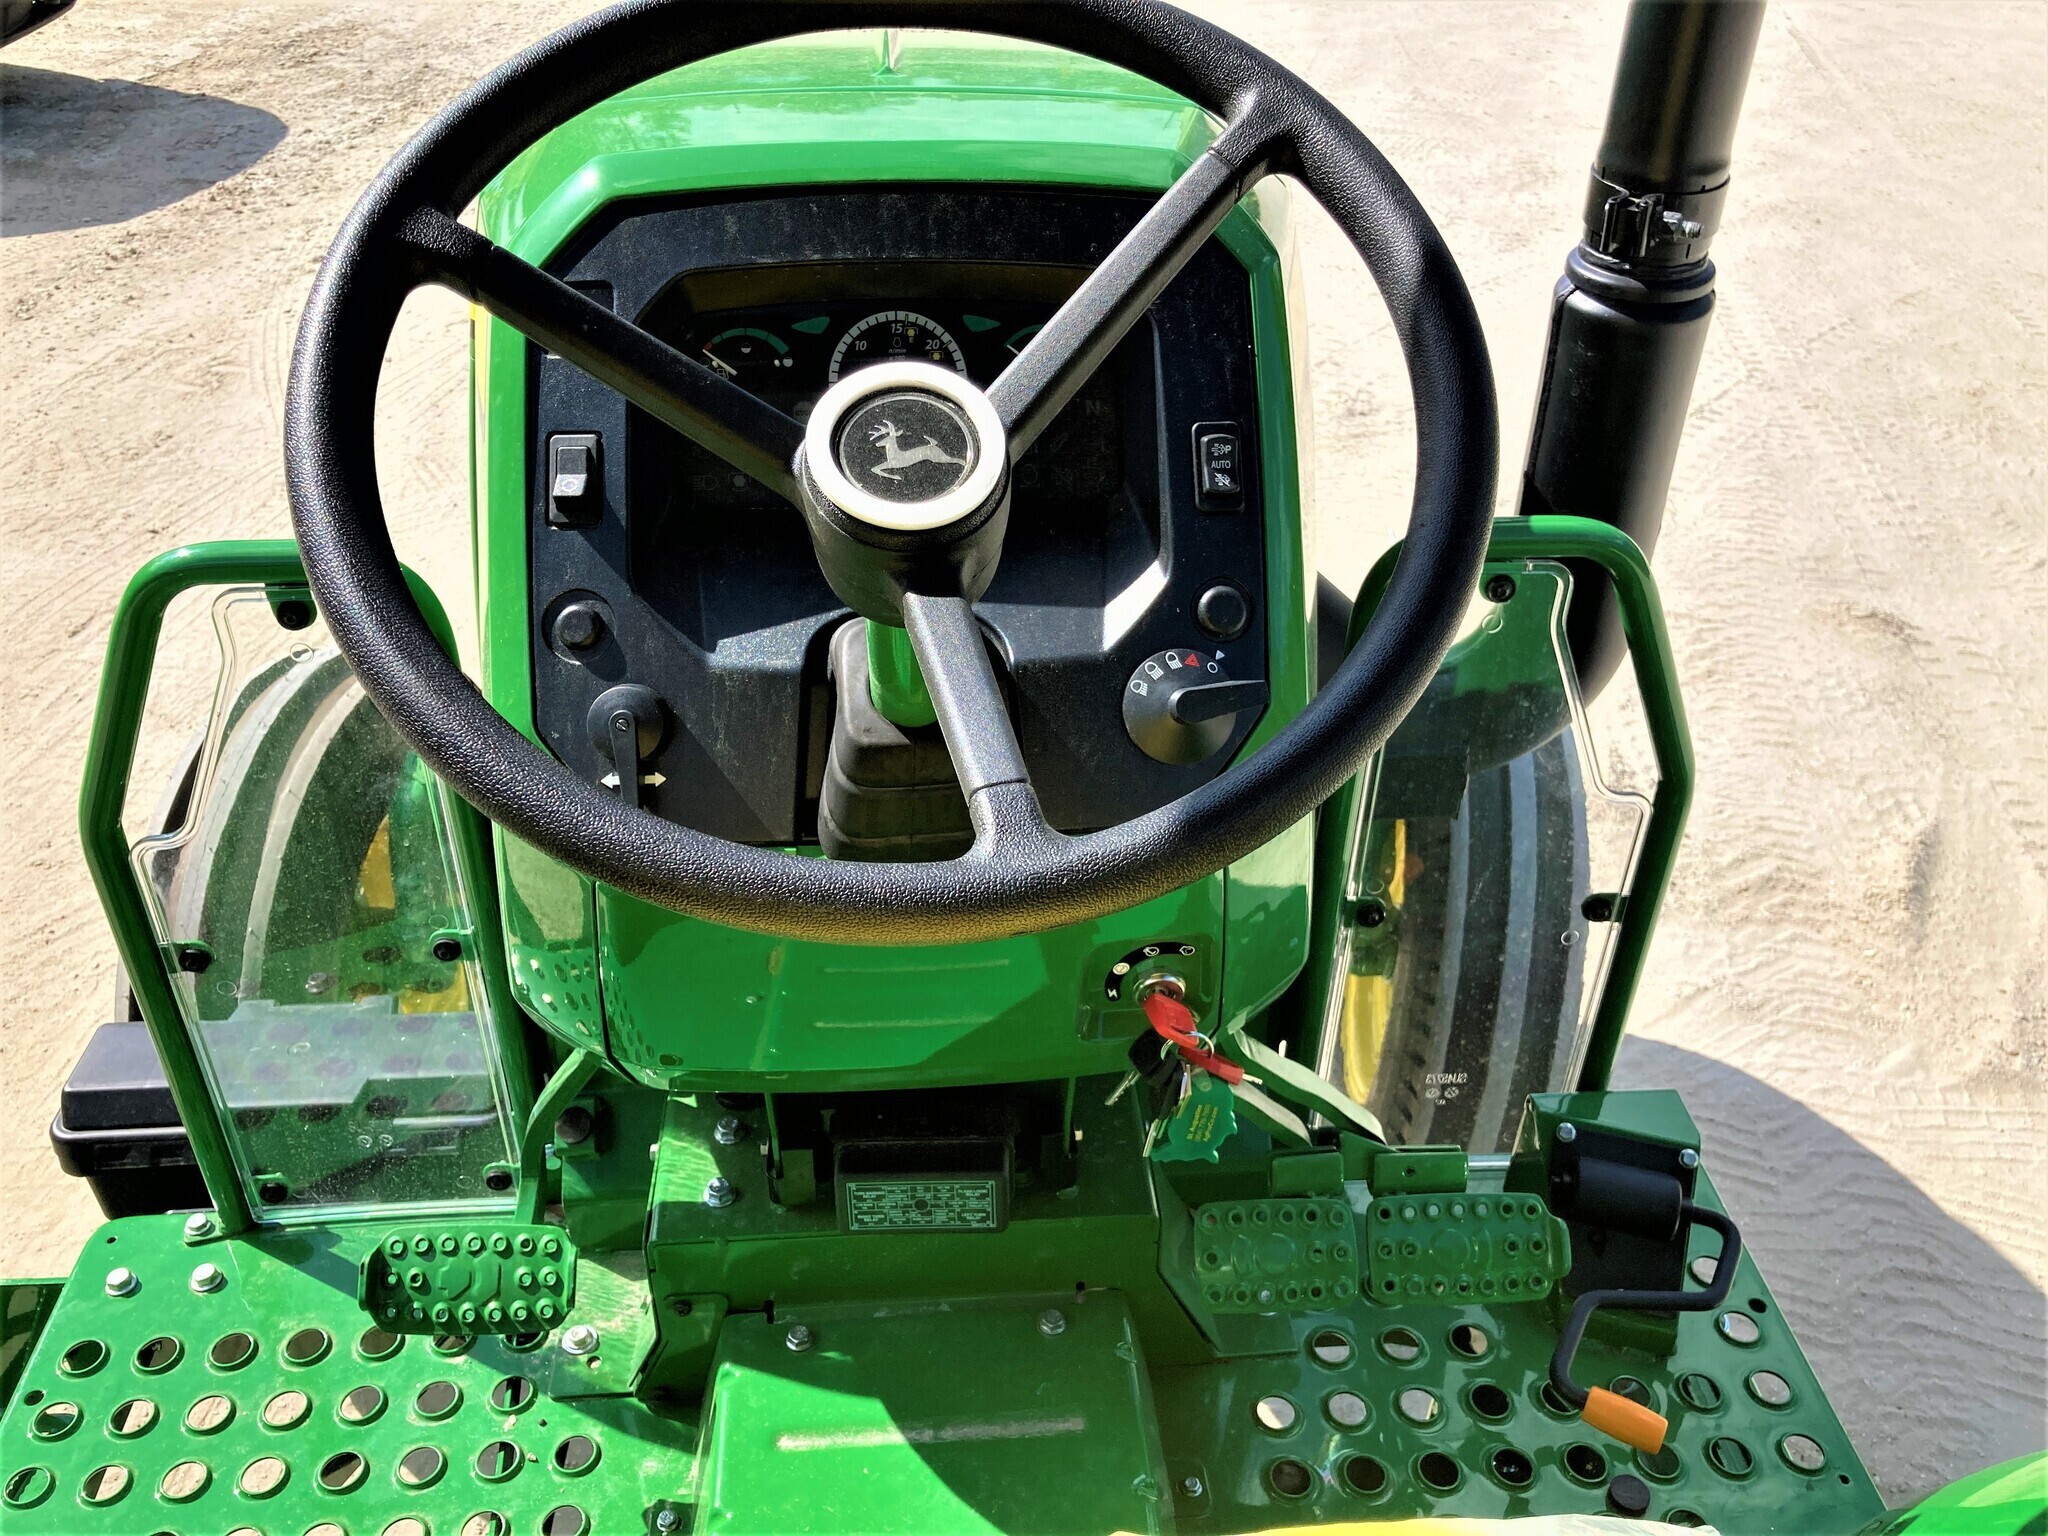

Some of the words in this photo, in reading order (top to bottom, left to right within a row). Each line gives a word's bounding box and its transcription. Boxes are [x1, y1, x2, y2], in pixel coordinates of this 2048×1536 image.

[890, 323, 904, 334] 15
[854, 340, 867, 351] 10
[924, 339, 940, 350] 20
[1211, 460, 1231, 469] AUTO
